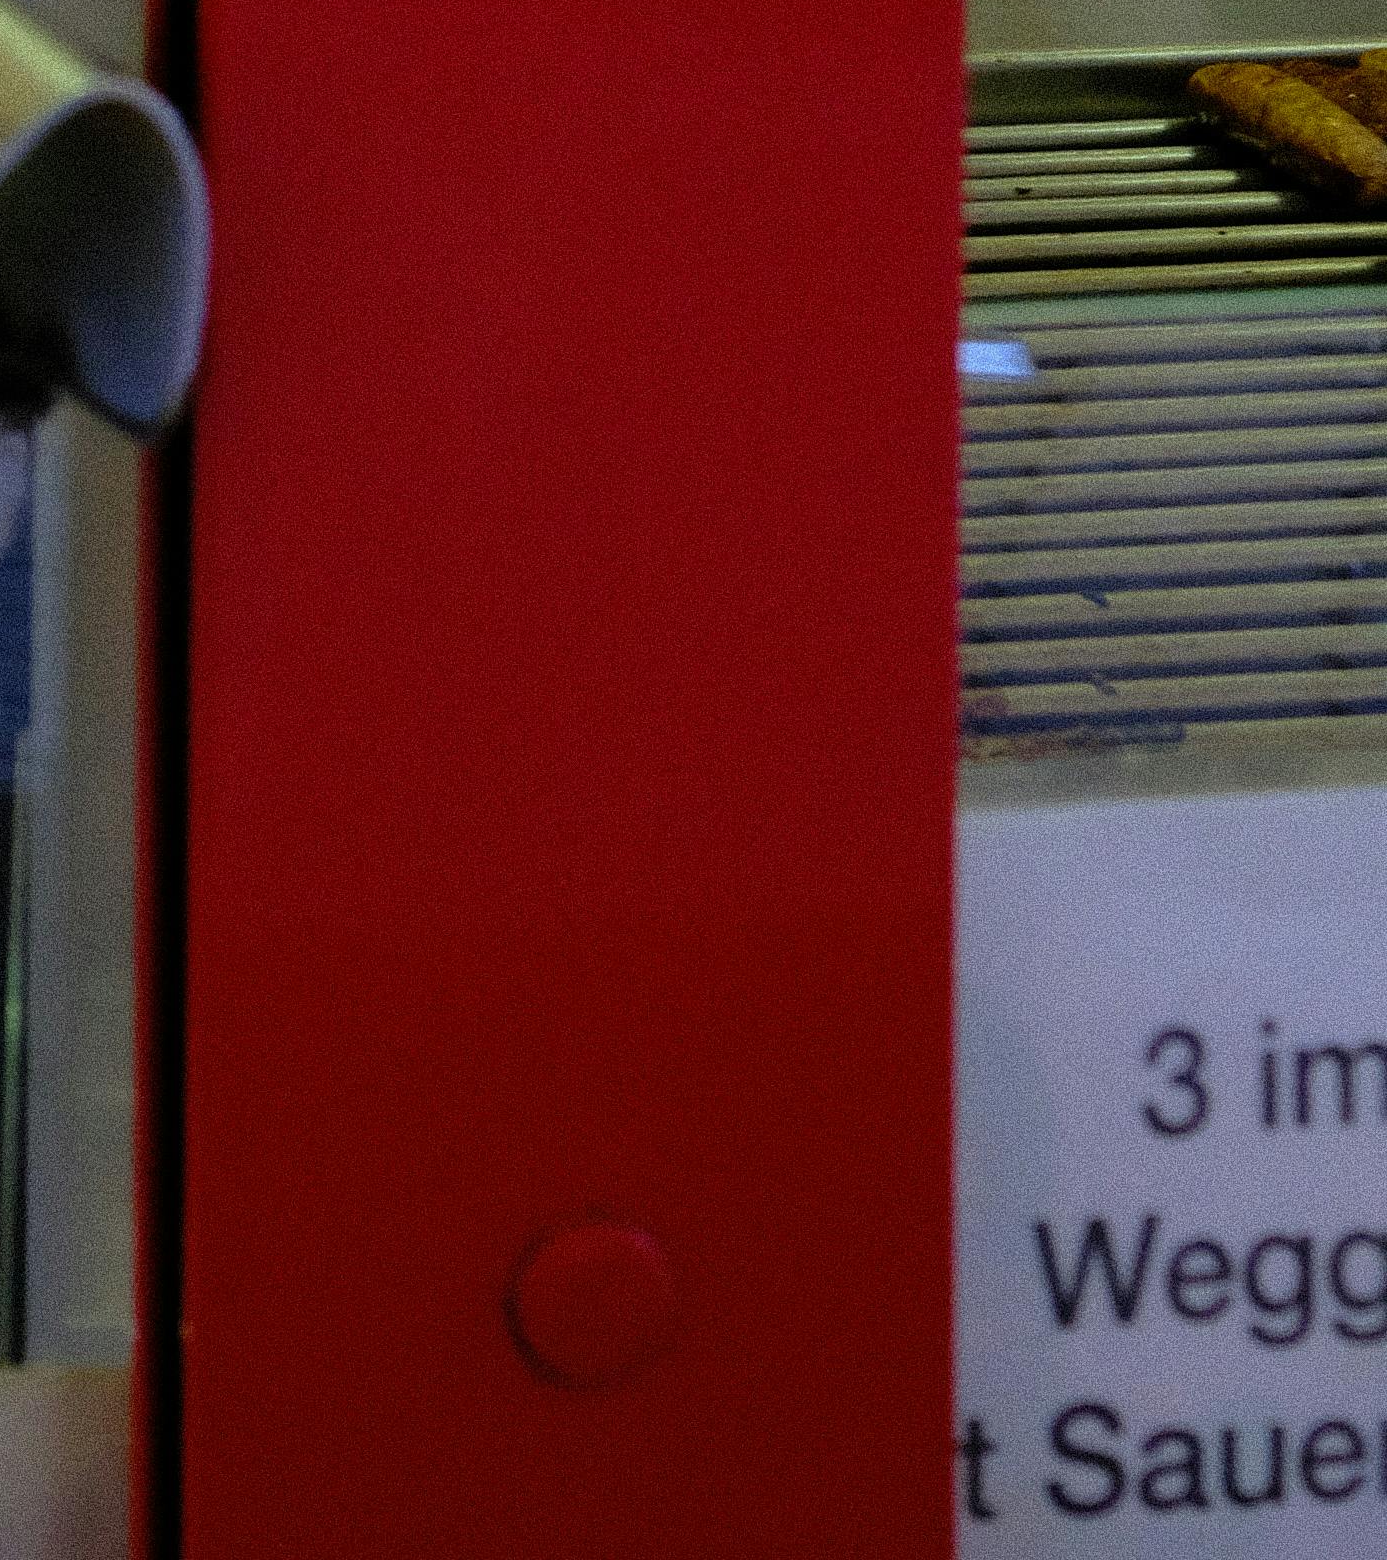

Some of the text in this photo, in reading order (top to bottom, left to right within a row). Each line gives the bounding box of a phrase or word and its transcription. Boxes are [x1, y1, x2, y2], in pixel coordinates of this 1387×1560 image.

[1141, 1017, 1387, 1138] 3 im
[1036, 1213, 1387, 1346] Wegg
[1047, 1400, 1387, 1519] Saue
